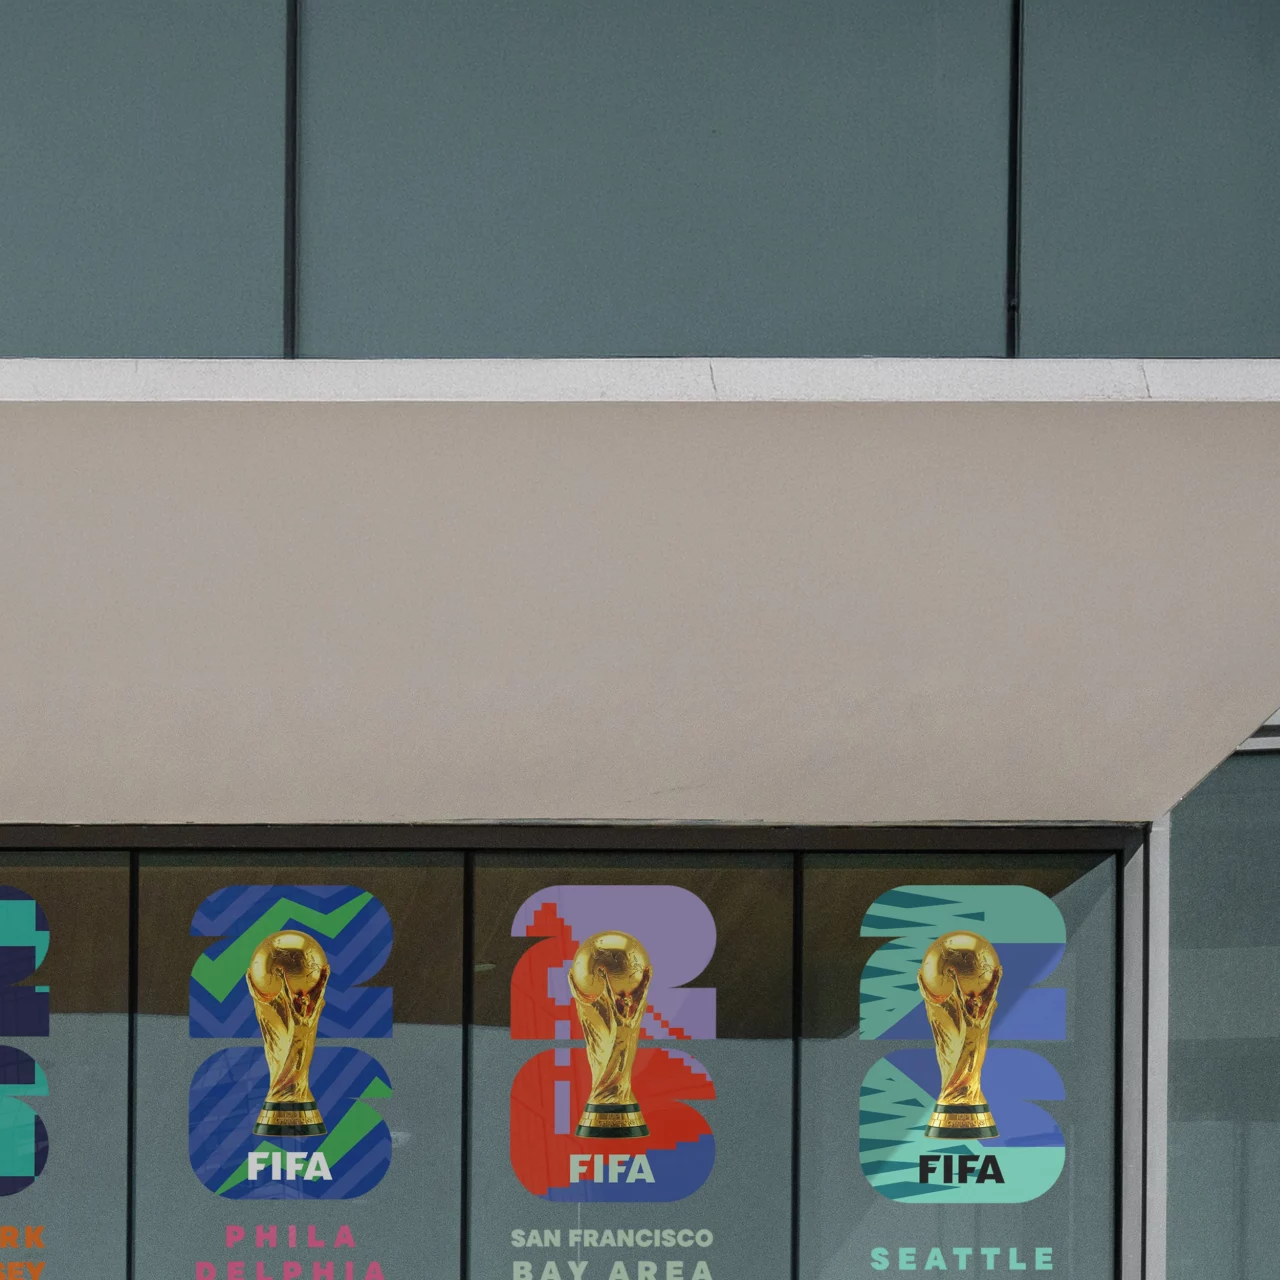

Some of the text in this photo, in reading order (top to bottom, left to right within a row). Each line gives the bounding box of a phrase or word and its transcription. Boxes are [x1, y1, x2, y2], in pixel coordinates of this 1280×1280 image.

[247, 1151, 333, 1181] FIFA
[569, 1154, 656, 1183] FIFA
[919, 1155, 1005, 1184] FIFA
[226, 1225, 356, 1248] PHILA
[511, 1228, 714, 1248] SAN FRANCISCO
[870, 1247, 1054, 1271] SEATTLE
